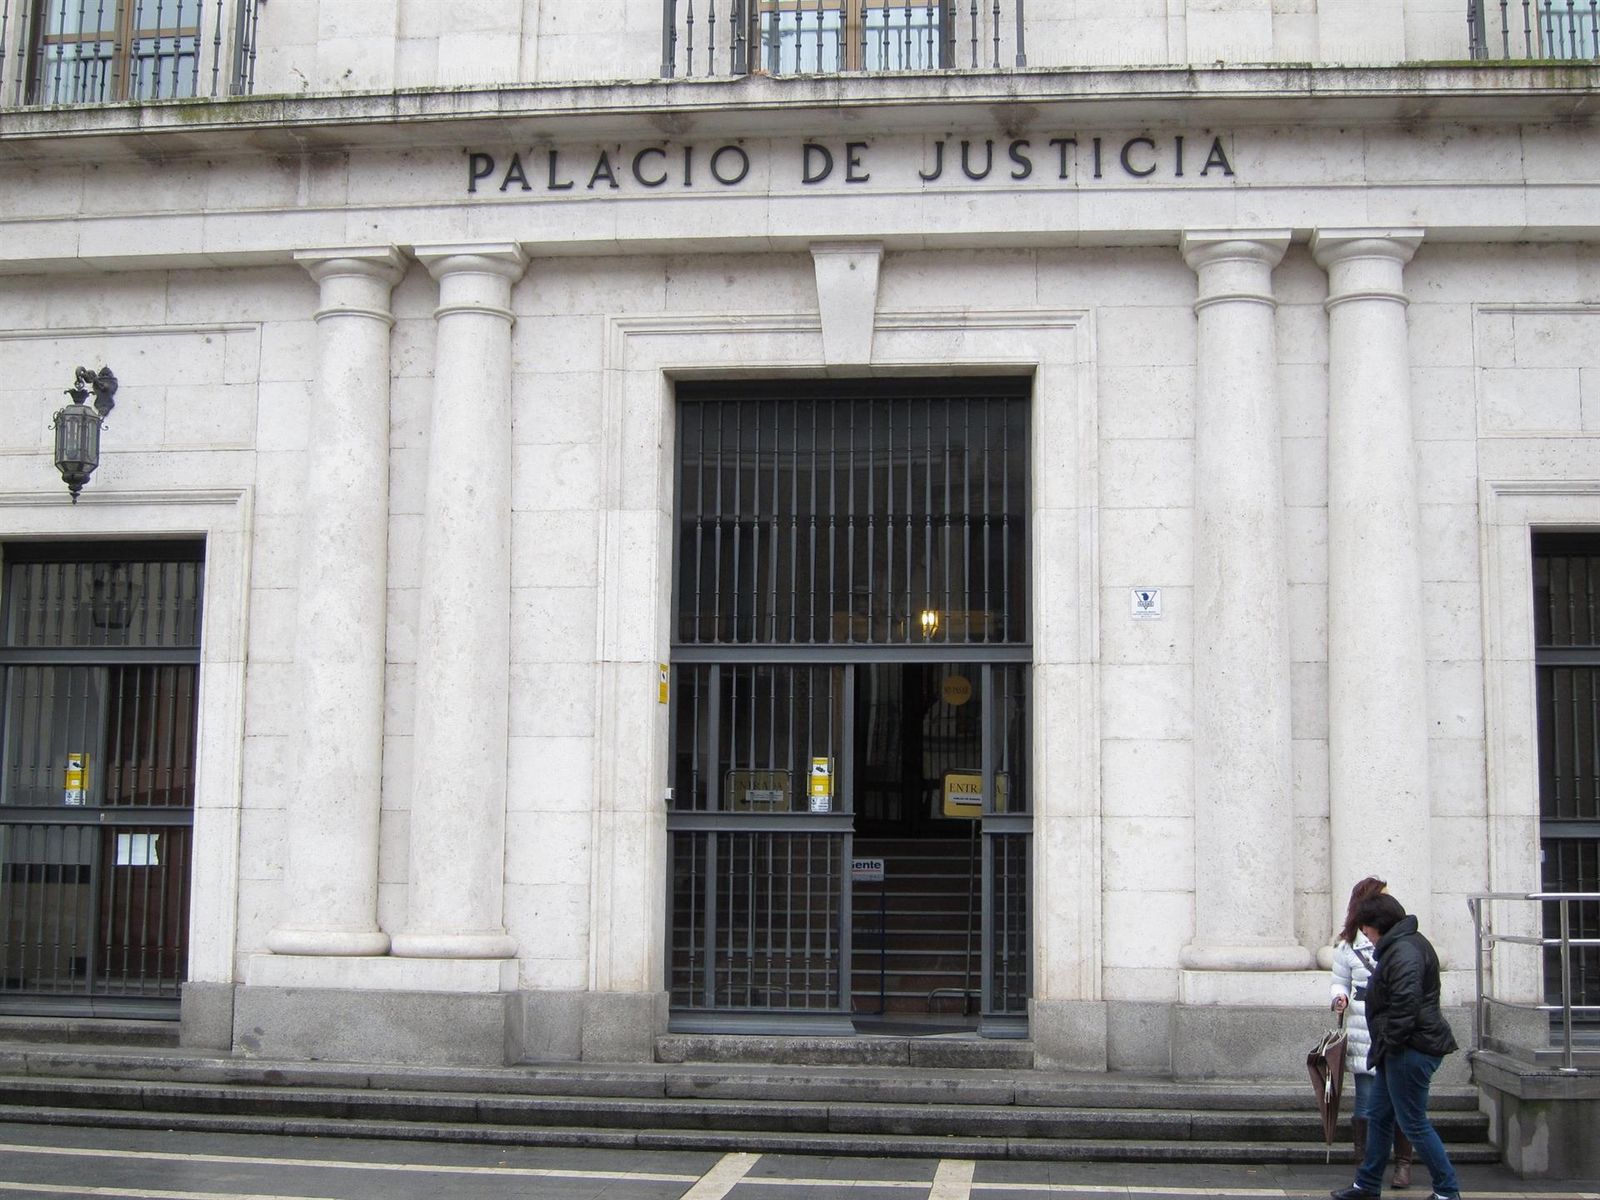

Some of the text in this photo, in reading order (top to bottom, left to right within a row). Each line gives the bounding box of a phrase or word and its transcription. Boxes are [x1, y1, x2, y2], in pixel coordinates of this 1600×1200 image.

[468, 135, 1236, 192] PALACIO DE JUSTICIA
[950, 783, 1002, 794] ENTRA
